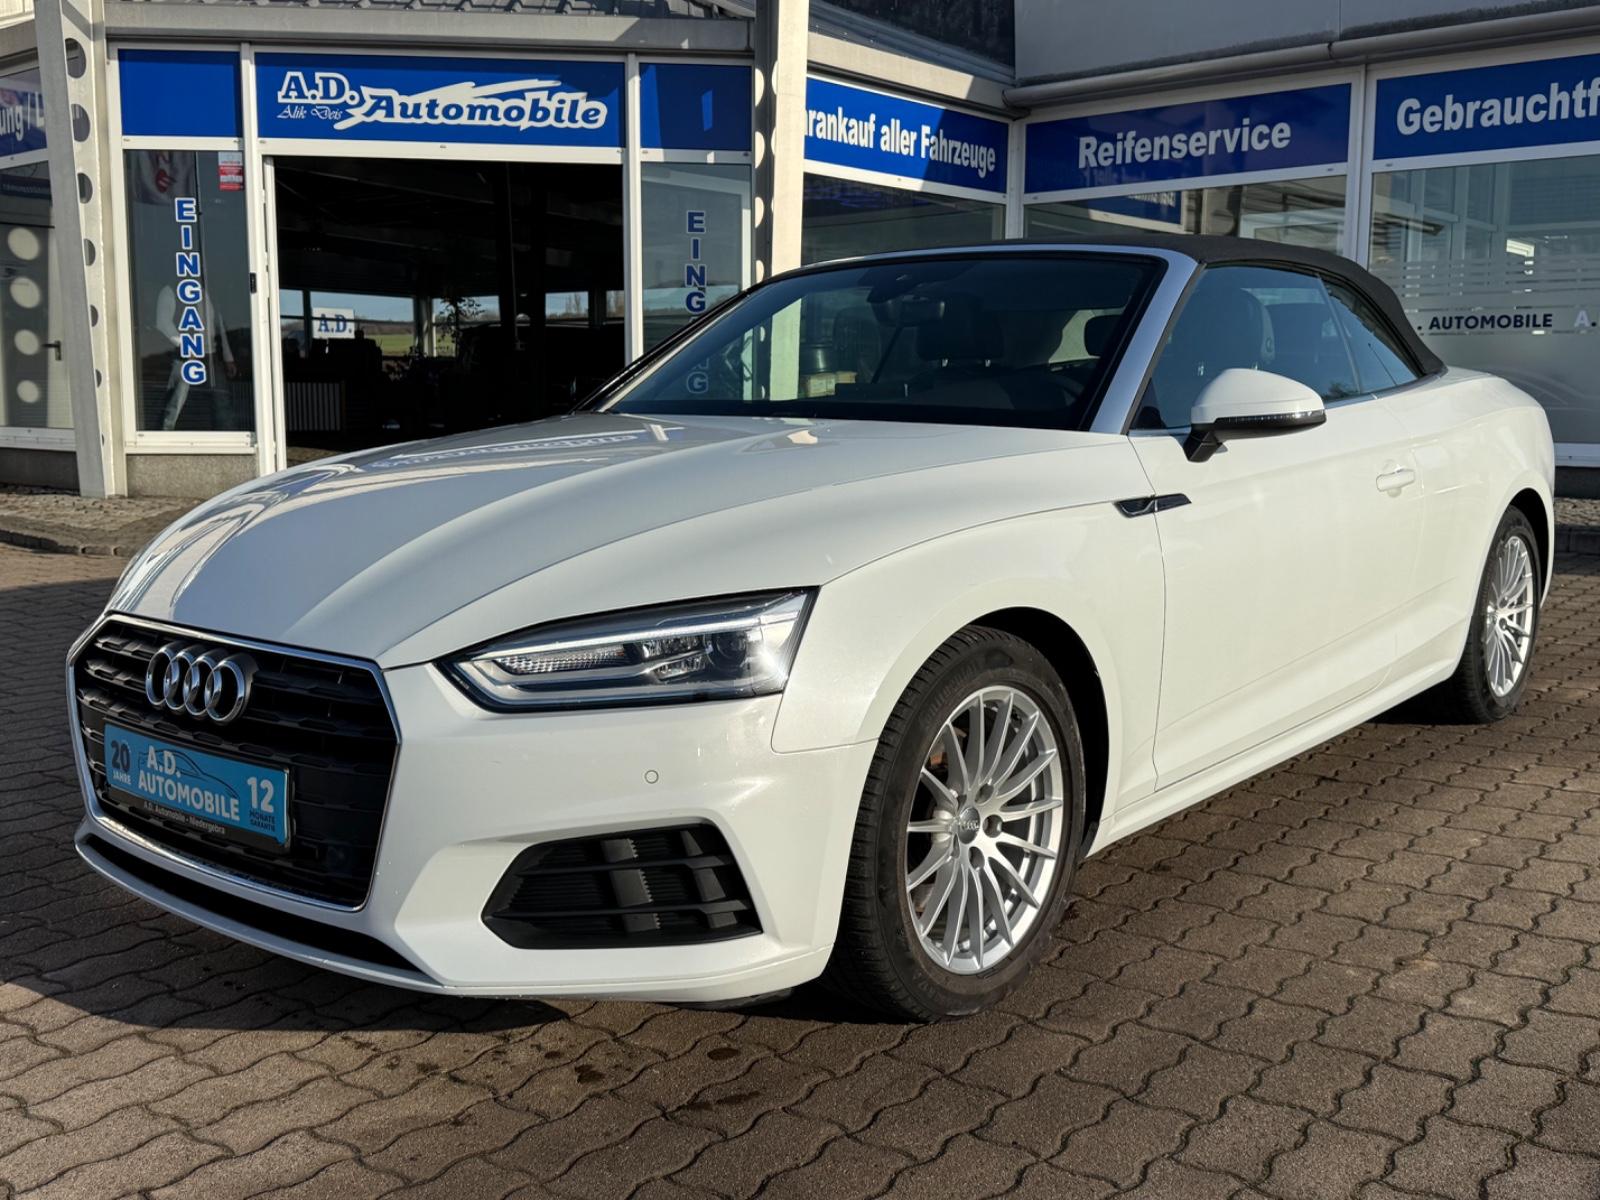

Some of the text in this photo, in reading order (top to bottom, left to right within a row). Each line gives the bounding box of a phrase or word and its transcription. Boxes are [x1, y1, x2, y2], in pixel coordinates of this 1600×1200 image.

[277, 105, 306, 119] Alik
[278, 71, 607, 130] A.D. Automobile
[880, 118, 917, 157] aller
[920, 124, 996, 178] Fahrzeuge
[1078, 117, 1292, 169] Reifenservice
[175, 197, 206, 384] EINGANG
[318, 313, 352, 333] A.D.
[1429, 313, 1553, 331] AUTOMOBILE
[110, 739, 131, 773] 20
[147, 744, 182, 778] A.D.
[138, 770, 241, 821] AUTOMOBILE
[247, 776, 274, 813] 12
